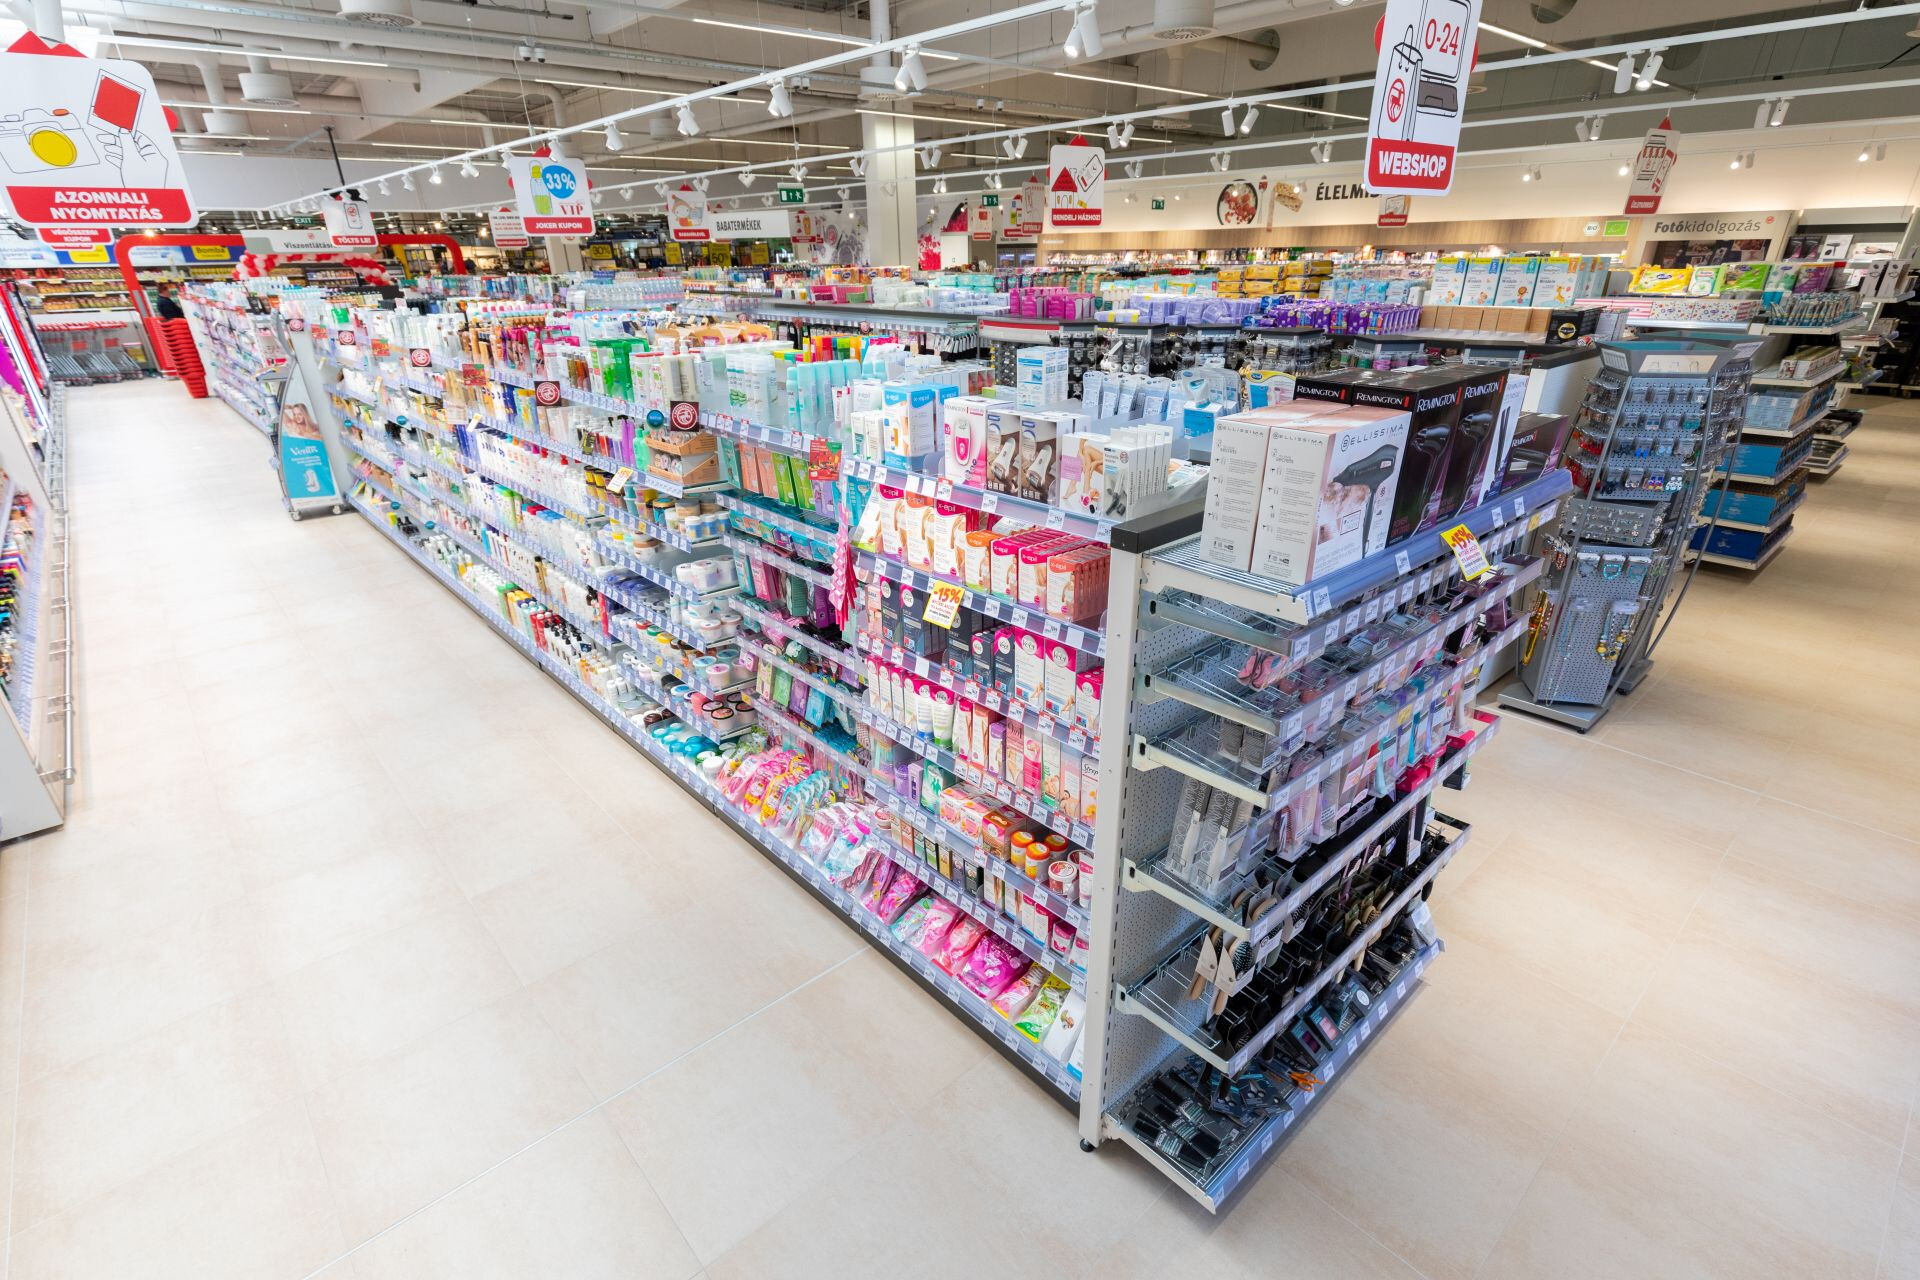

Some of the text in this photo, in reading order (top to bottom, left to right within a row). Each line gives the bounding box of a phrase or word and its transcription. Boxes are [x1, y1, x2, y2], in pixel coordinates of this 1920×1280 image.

[1425, 18, 1460, 56] 0-24
[1378, 150, 1447, 178] WEBSHOP
[545, 173, 577, 190] 33%
[55, 191, 149, 204] AZONNALI
[50, 205, 163, 220] NYOMTATÁS
[560, 204, 584, 216] VIP
[716, 218, 762, 232] BABATERMÉKEK
[1654, 219, 1761, 235] Fotókidolgozás
[1296, 385, 1340, 397] REMINGTON
[1464, 381, 1499, 399] REMINGTON
[1356, 392, 1403, 405] REMINGTON
[1416, 392, 1456, 413] REMINGTON
[1341, 424, 1404, 453] BELLISSIMA
[883, 488, 899, 496] x-epil
[937, 503, 955, 513] x-epil
[1451, 527, 1474, 549] -15%
[994, 545, 1008, 553] x-epil
[1022, 554, 1038, 563] x-epil
[1050, 562, 1067, 570] x-epil
[933, 587, 960, 604] -15%
